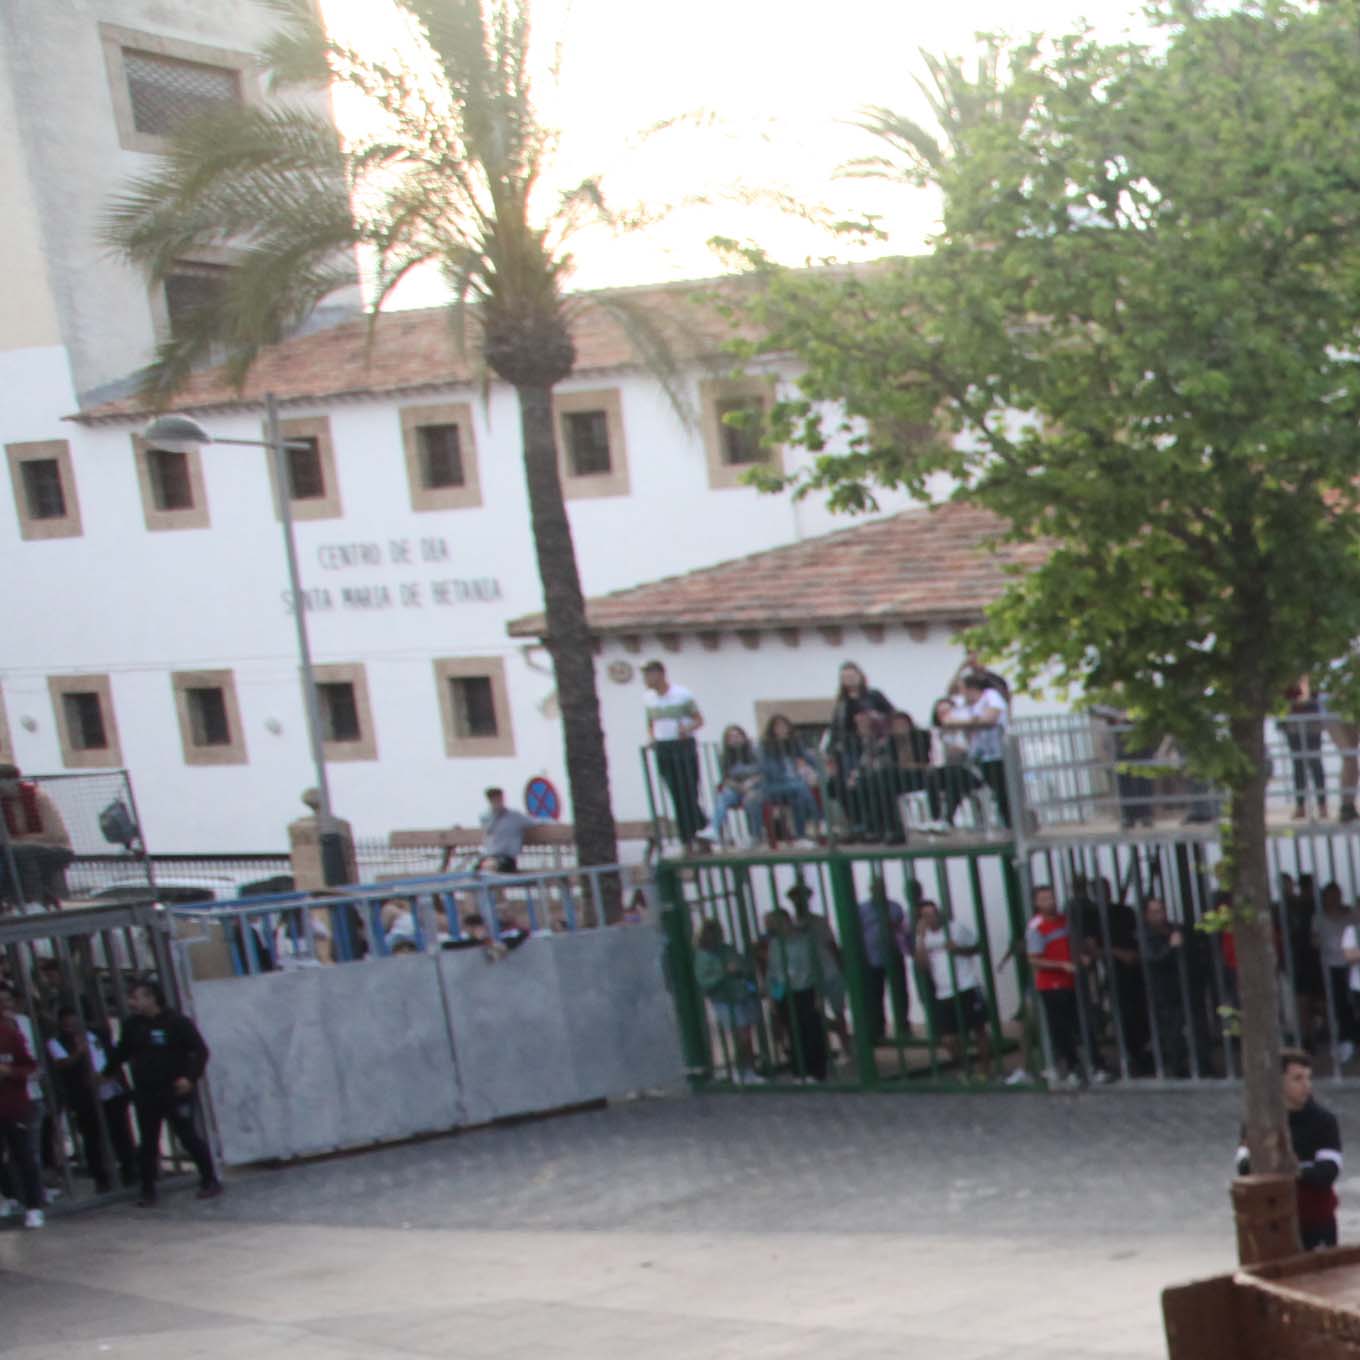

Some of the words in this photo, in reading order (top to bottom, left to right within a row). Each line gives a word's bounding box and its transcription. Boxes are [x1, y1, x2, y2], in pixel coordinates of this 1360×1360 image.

[317, 542, 383, 569] CENTRO
[389, 538, 411, 564] DE
[280, 586, 332, 615] SNTA
[400, 581, 422, 607] DE
[430, 578, 504, 605] BETANIA
